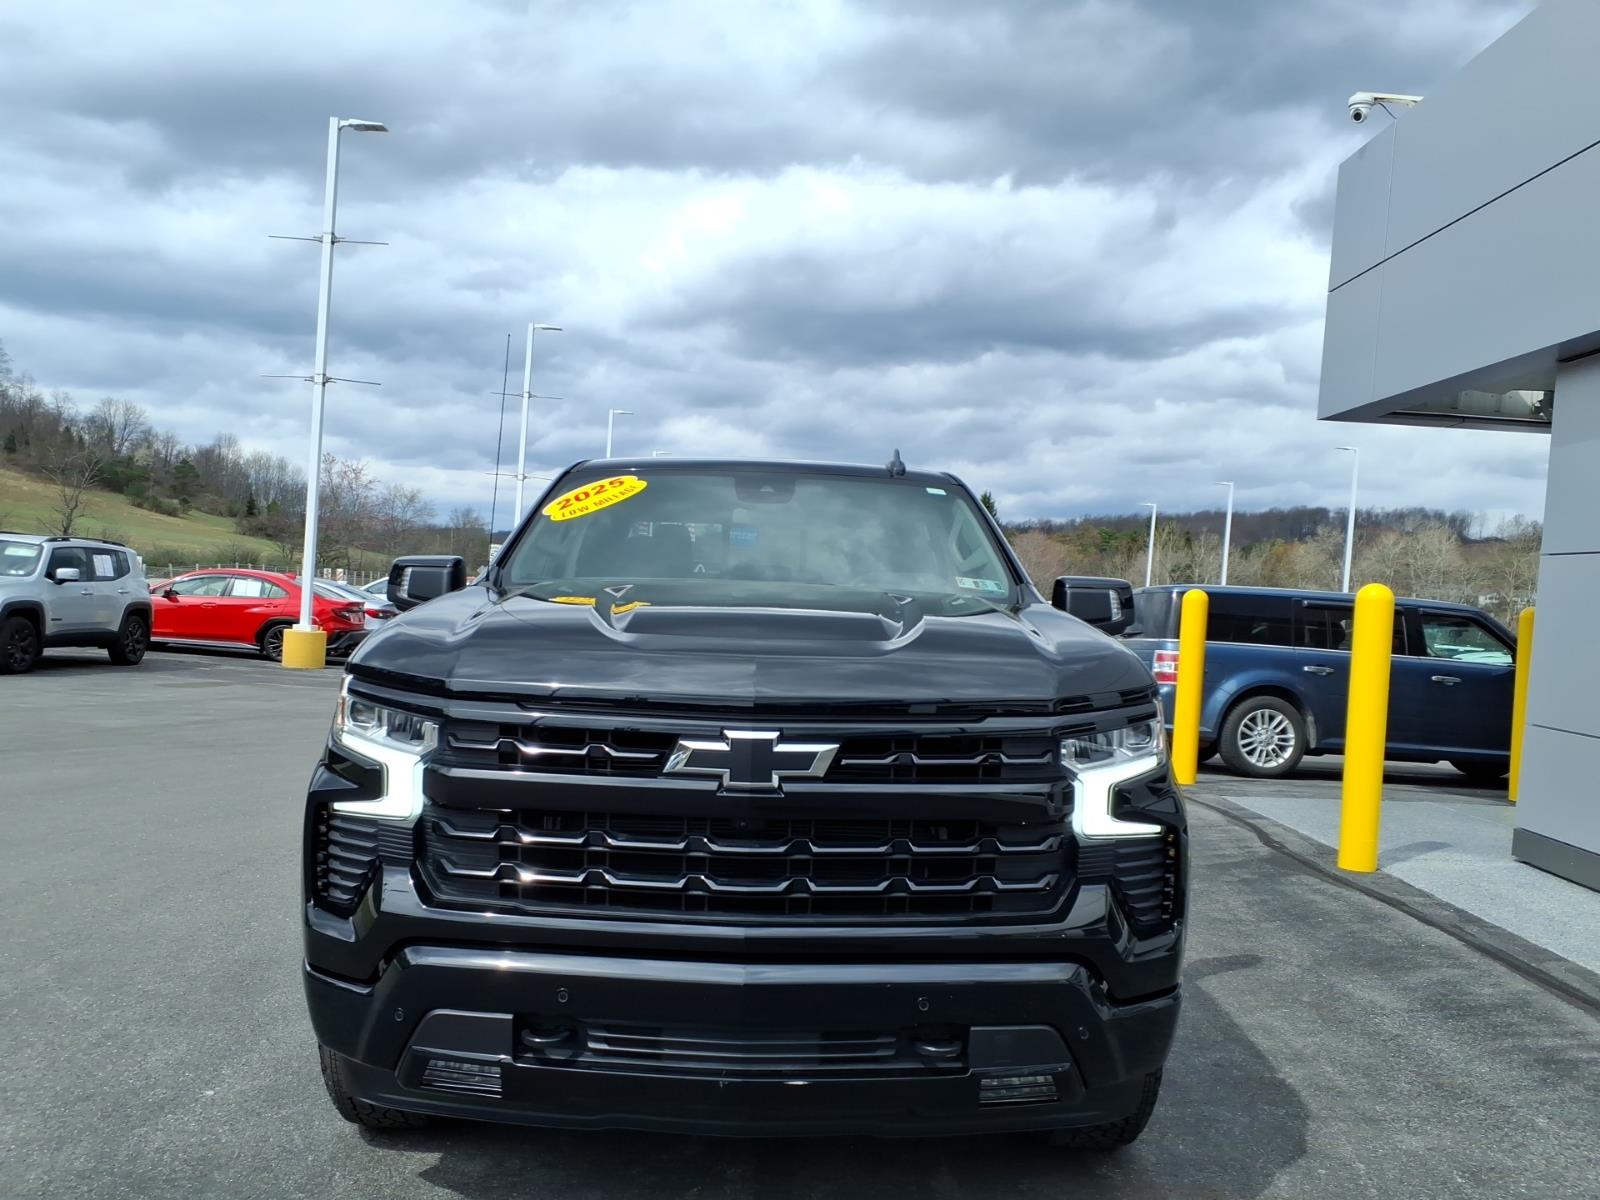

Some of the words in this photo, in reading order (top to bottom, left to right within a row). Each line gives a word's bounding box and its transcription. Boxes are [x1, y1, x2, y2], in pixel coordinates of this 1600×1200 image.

[556, 478, 625, 511] 2025
[561, 505, 590, 518] LOW
[592, 485, 638, 508] MILEAGE
